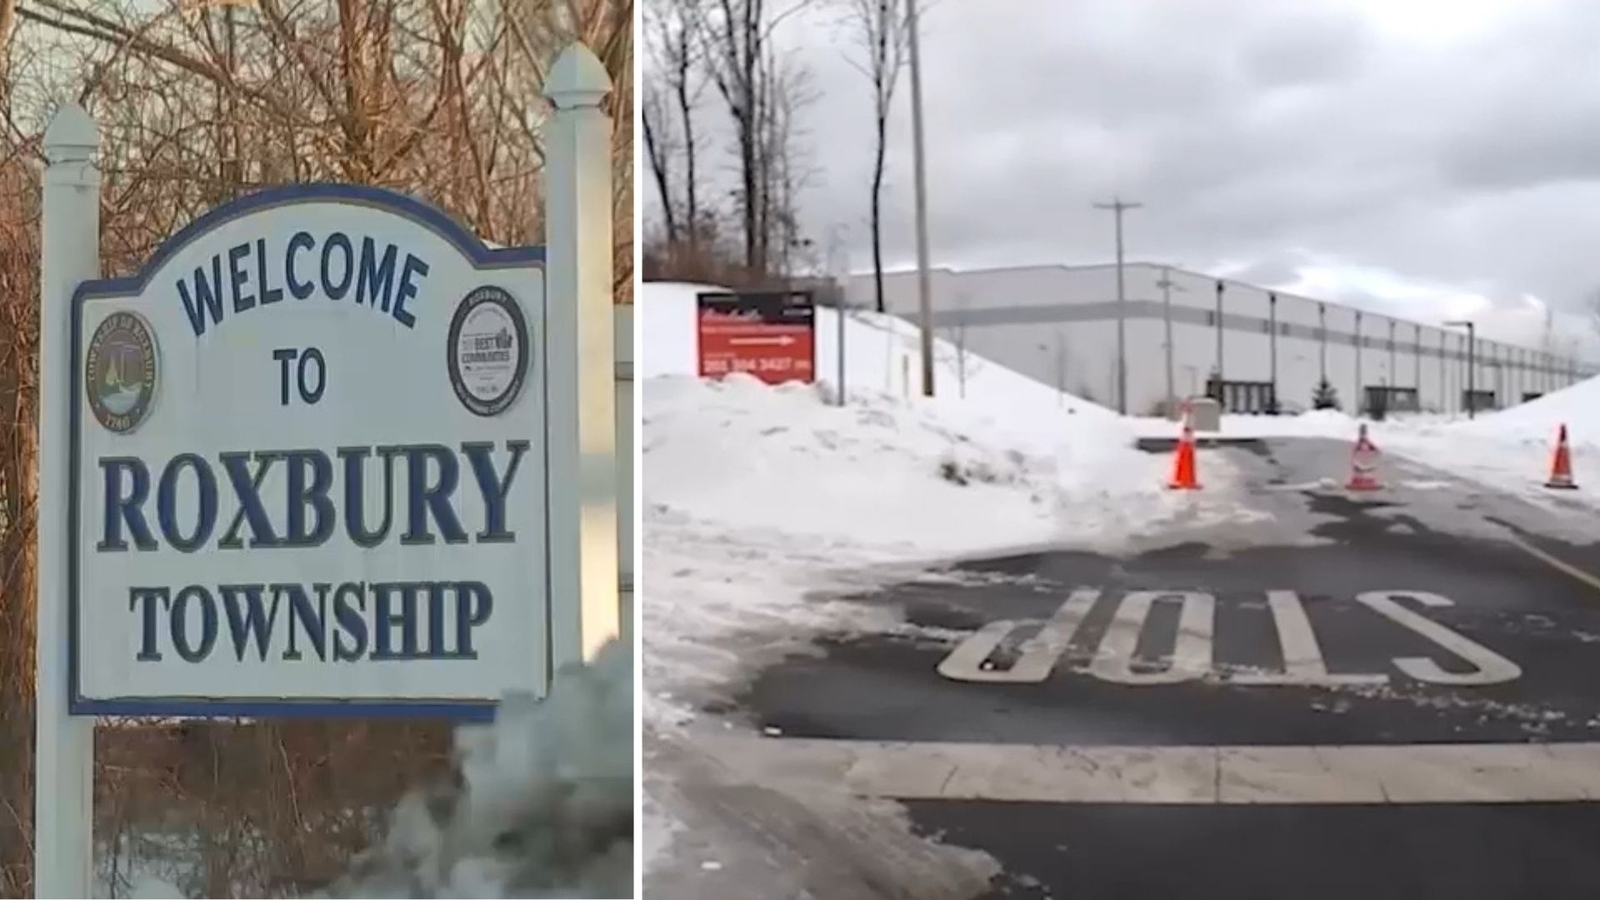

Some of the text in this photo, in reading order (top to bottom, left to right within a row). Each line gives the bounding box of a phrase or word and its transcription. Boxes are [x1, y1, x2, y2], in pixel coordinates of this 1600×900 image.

[176, 231, 429, 337] WELCOME
[273, 347, 326, 406] TO
[97, 439, 530, 553] ROXBURY
[129, 580, 494, 663] TOWNSHIP
[937, 589, 1522, 684] STOP
